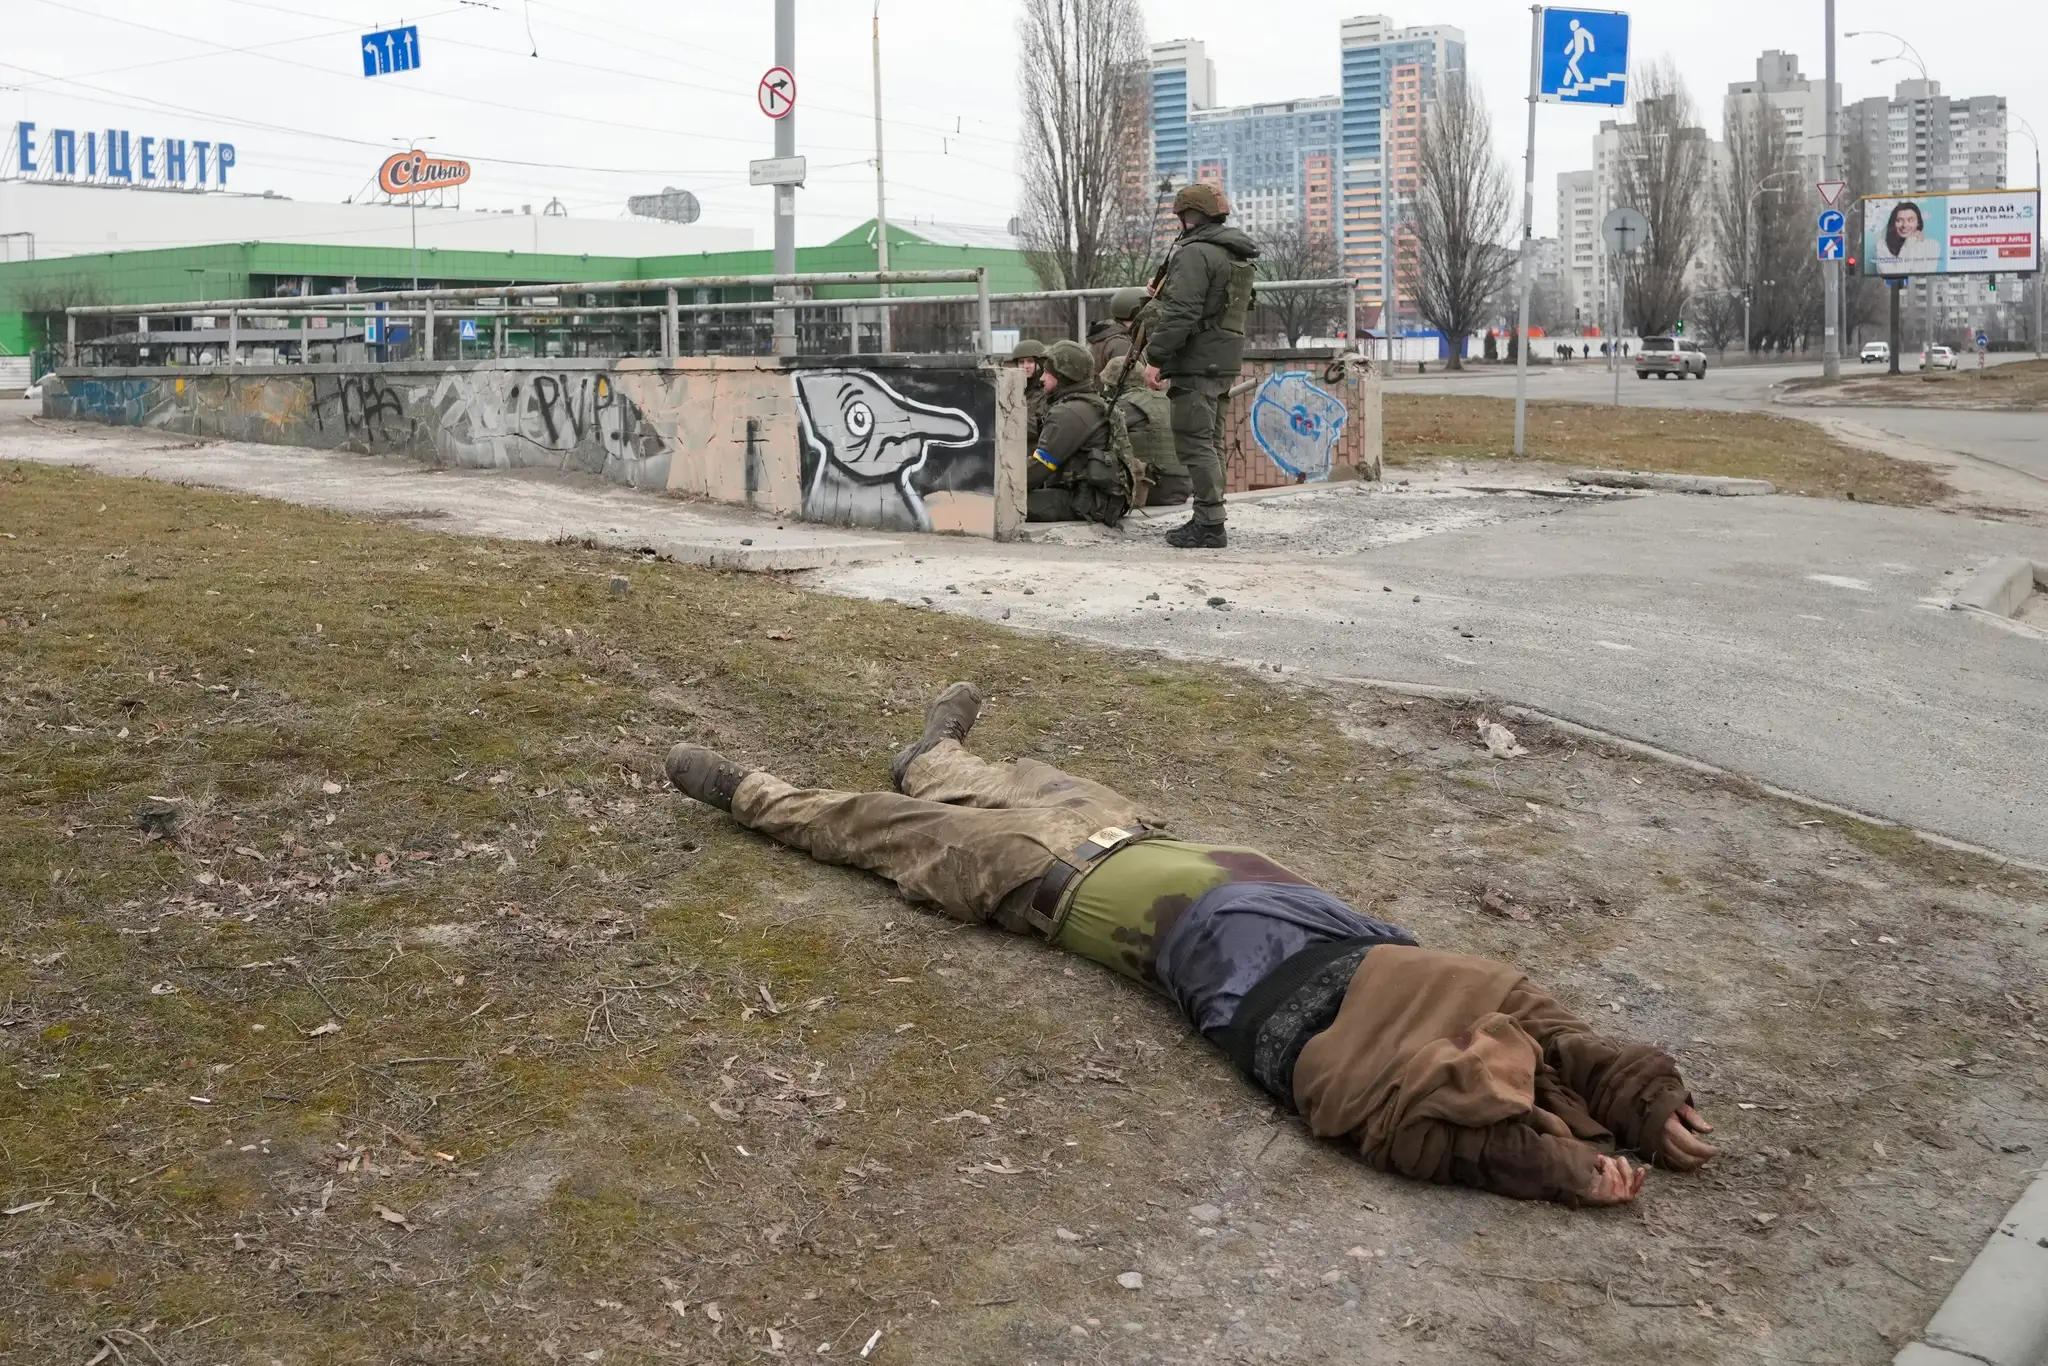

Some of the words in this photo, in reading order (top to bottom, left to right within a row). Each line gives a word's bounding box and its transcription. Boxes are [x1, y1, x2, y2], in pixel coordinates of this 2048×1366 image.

[17, 121, 236, 184] ЕПІЦЕНТР
[389, 156, 466, 186] Сільпо
[1950, 203, 2014, 215] ВИГРАВАЙ
[1952, 237, 2007, 245] BLOCKBUSTER
[2007, 235, 2029, 244] MALL
